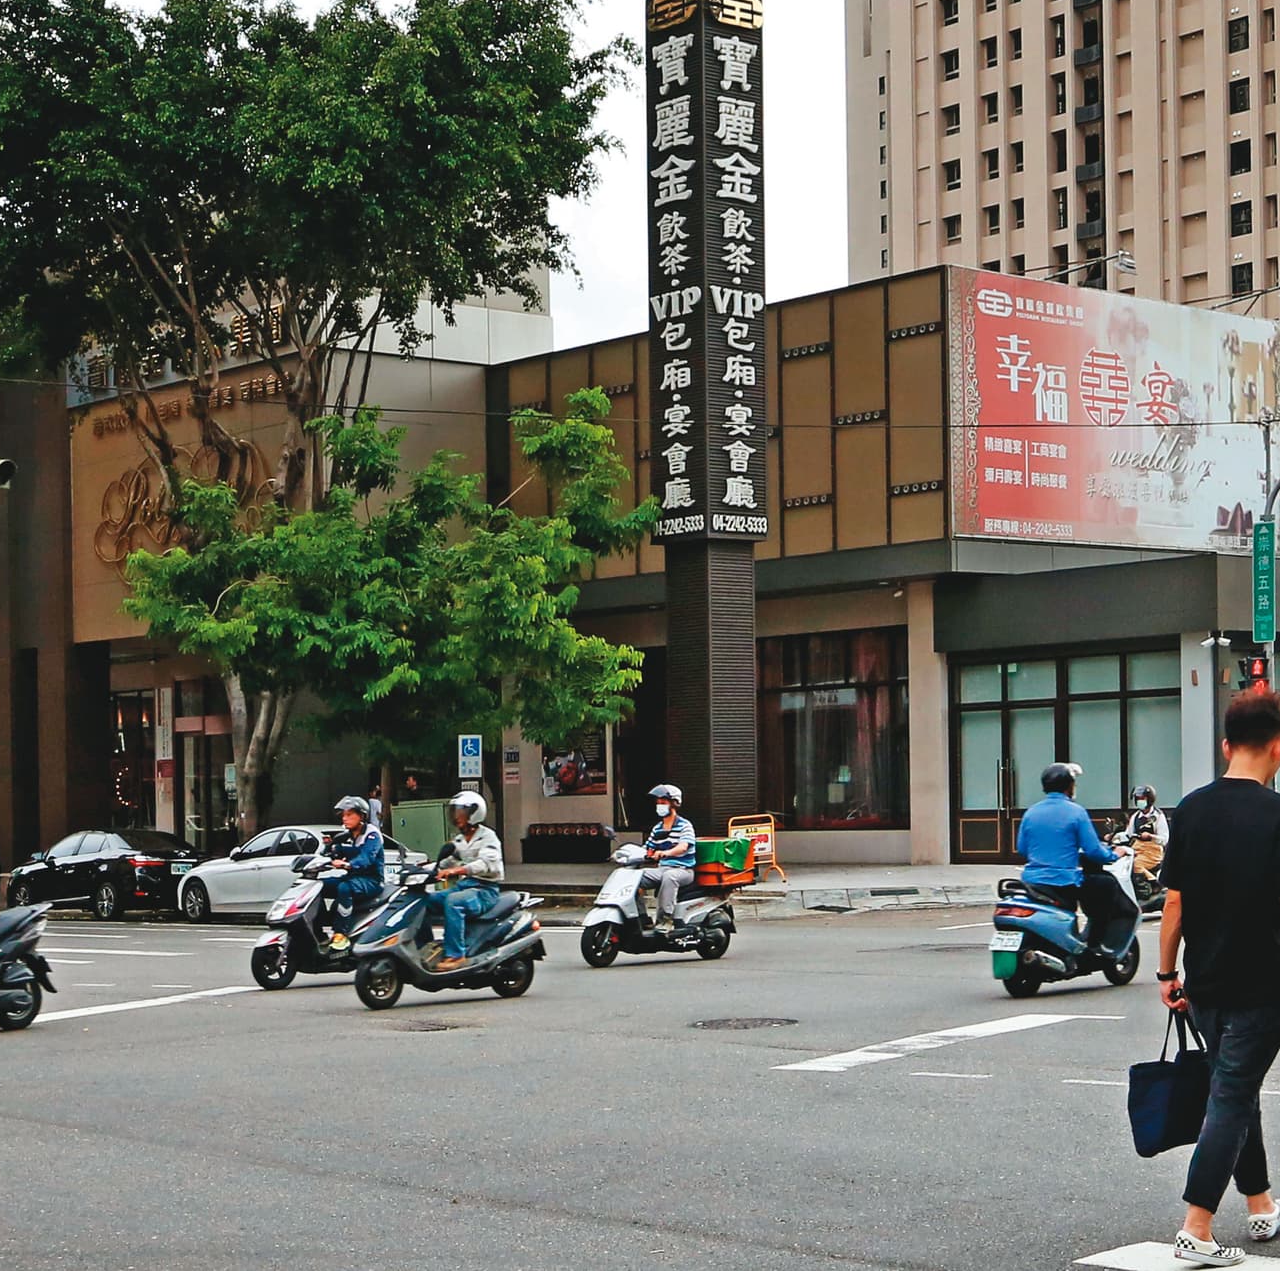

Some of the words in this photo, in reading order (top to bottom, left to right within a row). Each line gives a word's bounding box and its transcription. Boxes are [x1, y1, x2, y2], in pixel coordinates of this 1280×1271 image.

[712, 514, 768, 534] 04-2242-5333
[1258, 536, 1270, 610] 崇德五路
